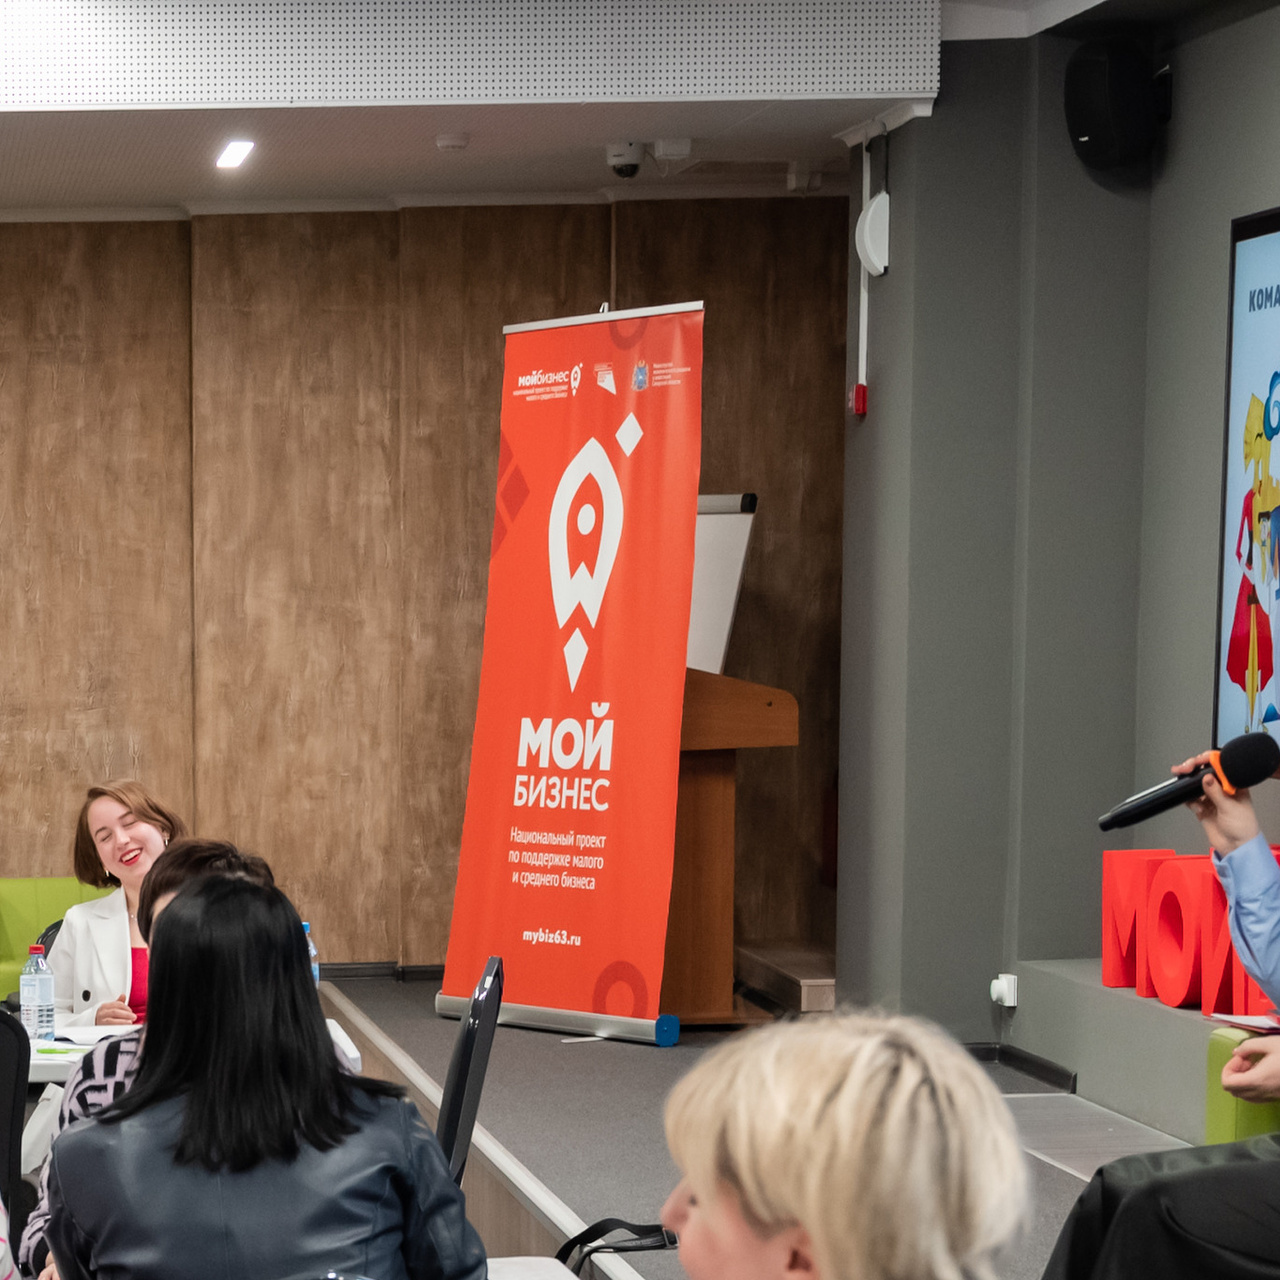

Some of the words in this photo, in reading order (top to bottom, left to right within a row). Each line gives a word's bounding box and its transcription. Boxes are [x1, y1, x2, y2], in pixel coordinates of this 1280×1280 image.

[517, 702, 614, 771] МОЙ
[513, 775, 611, 812] БИЗНЕС
[510, 826, 575, 846] Национальный
[575, 833, 607, 850] проект
[508, 850, 520, 863] по
[521, 851, 571, 869] поддержке
[572, 855, 604, 870] малого
[512, 871, 519, 883] и
[520, 871, 560, 888] среднего
[561, 871, 596, 890] бизнеса
[522, 928, 582, 946] mybiz63.ru
